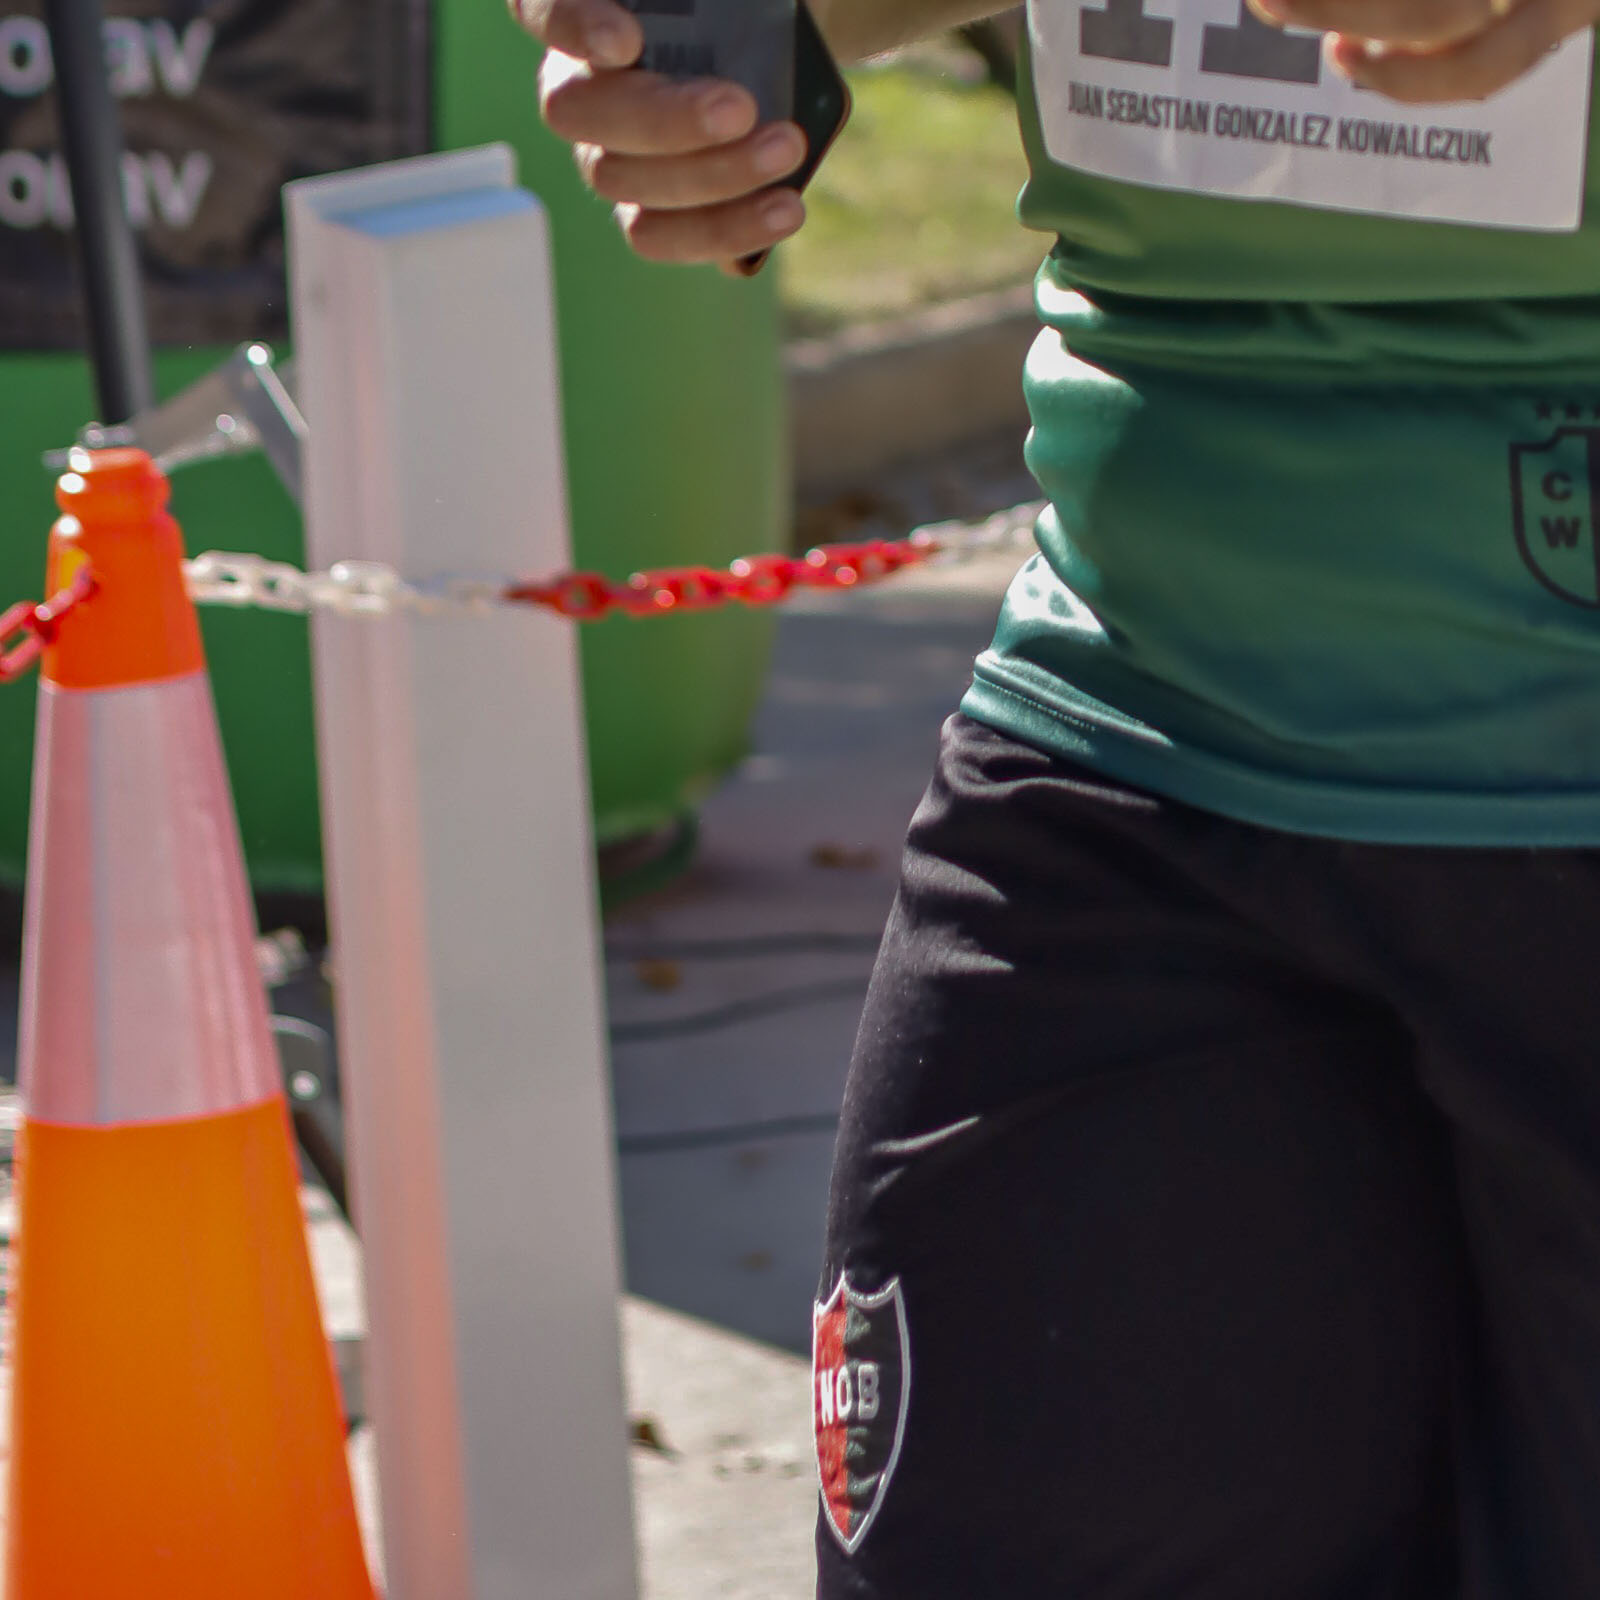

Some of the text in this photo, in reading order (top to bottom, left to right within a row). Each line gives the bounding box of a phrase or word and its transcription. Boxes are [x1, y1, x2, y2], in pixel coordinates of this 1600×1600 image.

[1068, 80, 1492, 165] JUAN SEBASTIAN GONZALEZ KOWALCZUK
[820, 1362, 880, 1428] NOB
